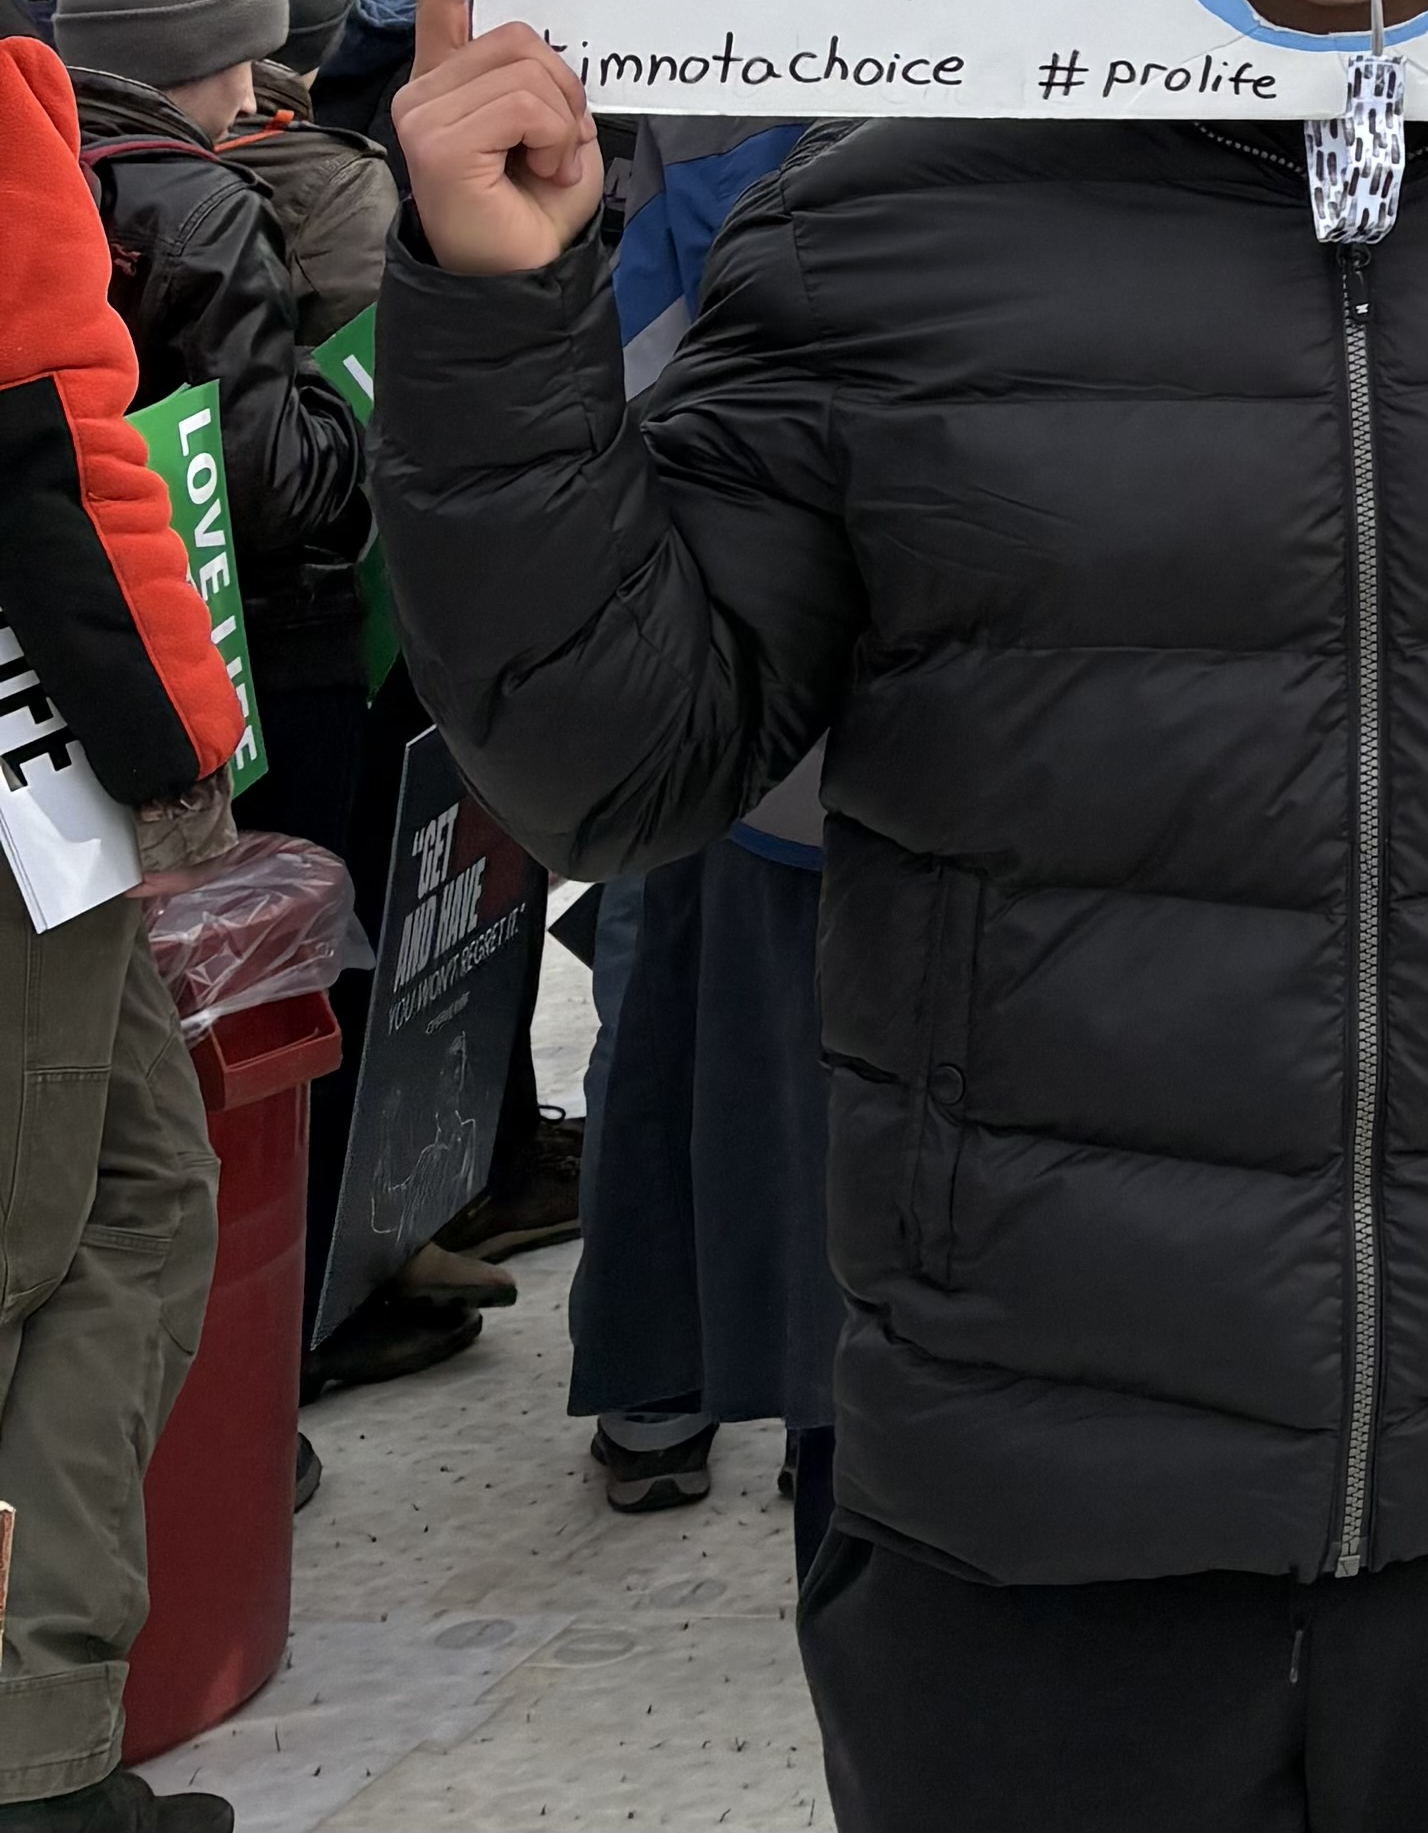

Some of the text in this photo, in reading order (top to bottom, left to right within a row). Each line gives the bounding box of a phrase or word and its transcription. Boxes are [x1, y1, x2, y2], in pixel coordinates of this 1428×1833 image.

[178, 407, 230, 602] LOVE
[394, 856, 487, 994] AND HAVE
